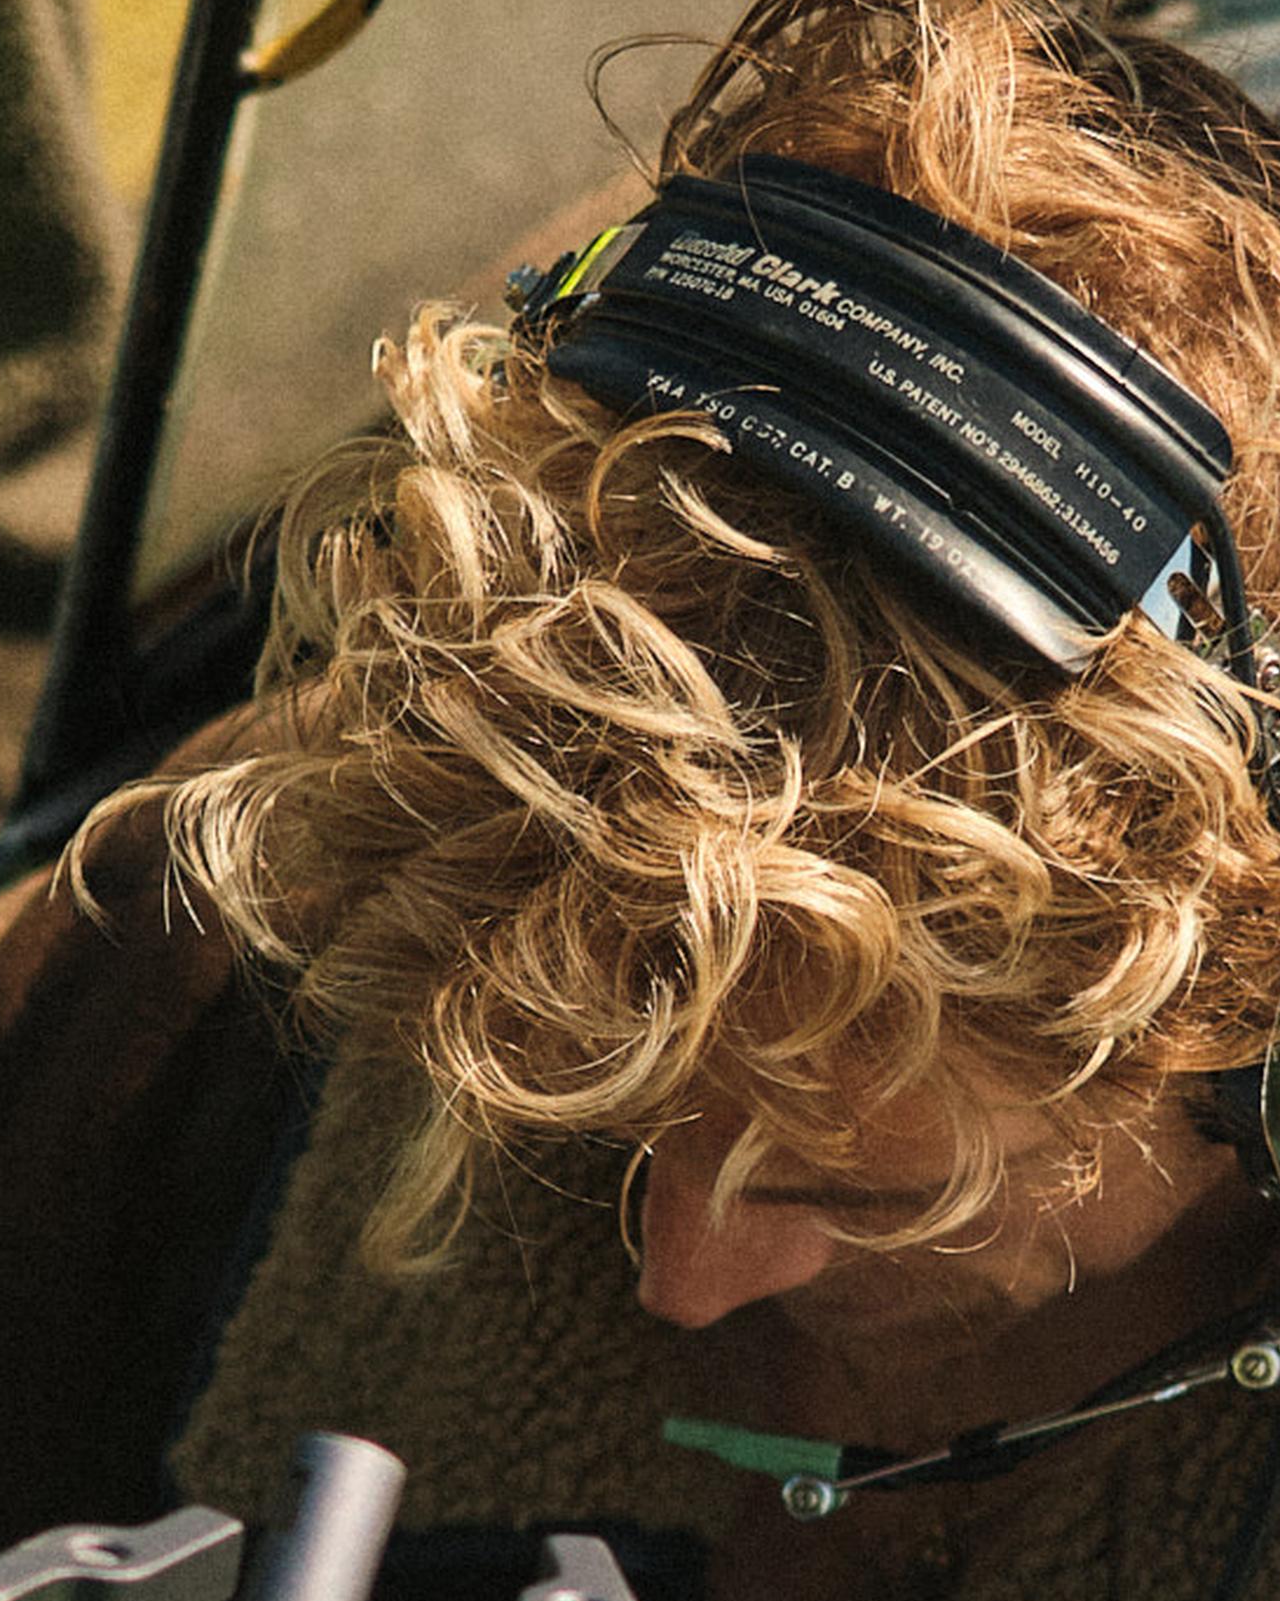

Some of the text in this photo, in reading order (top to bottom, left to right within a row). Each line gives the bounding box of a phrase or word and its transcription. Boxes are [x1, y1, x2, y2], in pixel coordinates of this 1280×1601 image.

[751, 253, 841, 304] Clark
[836, 299, 929, 360] COMPANY,
[928, 353, 965, 385] INC.
[763, 284, 795, 308] USA
[798, 301, 847, 331] 01604
[646, 375, 686, 399] FAA
[695, 392, 736, 420] TSO
[790, 441, 833, 477] CAT.
[837, 471, 856, 490] B
[874, 494, 907, 530] WT.
[919, 527, 945, 550] 19
[898, 379, 963, 427] PATENT
[959, 421, 1001, 458] NO'S
[1010, 410, 1147, 533] MODEL H10-40
